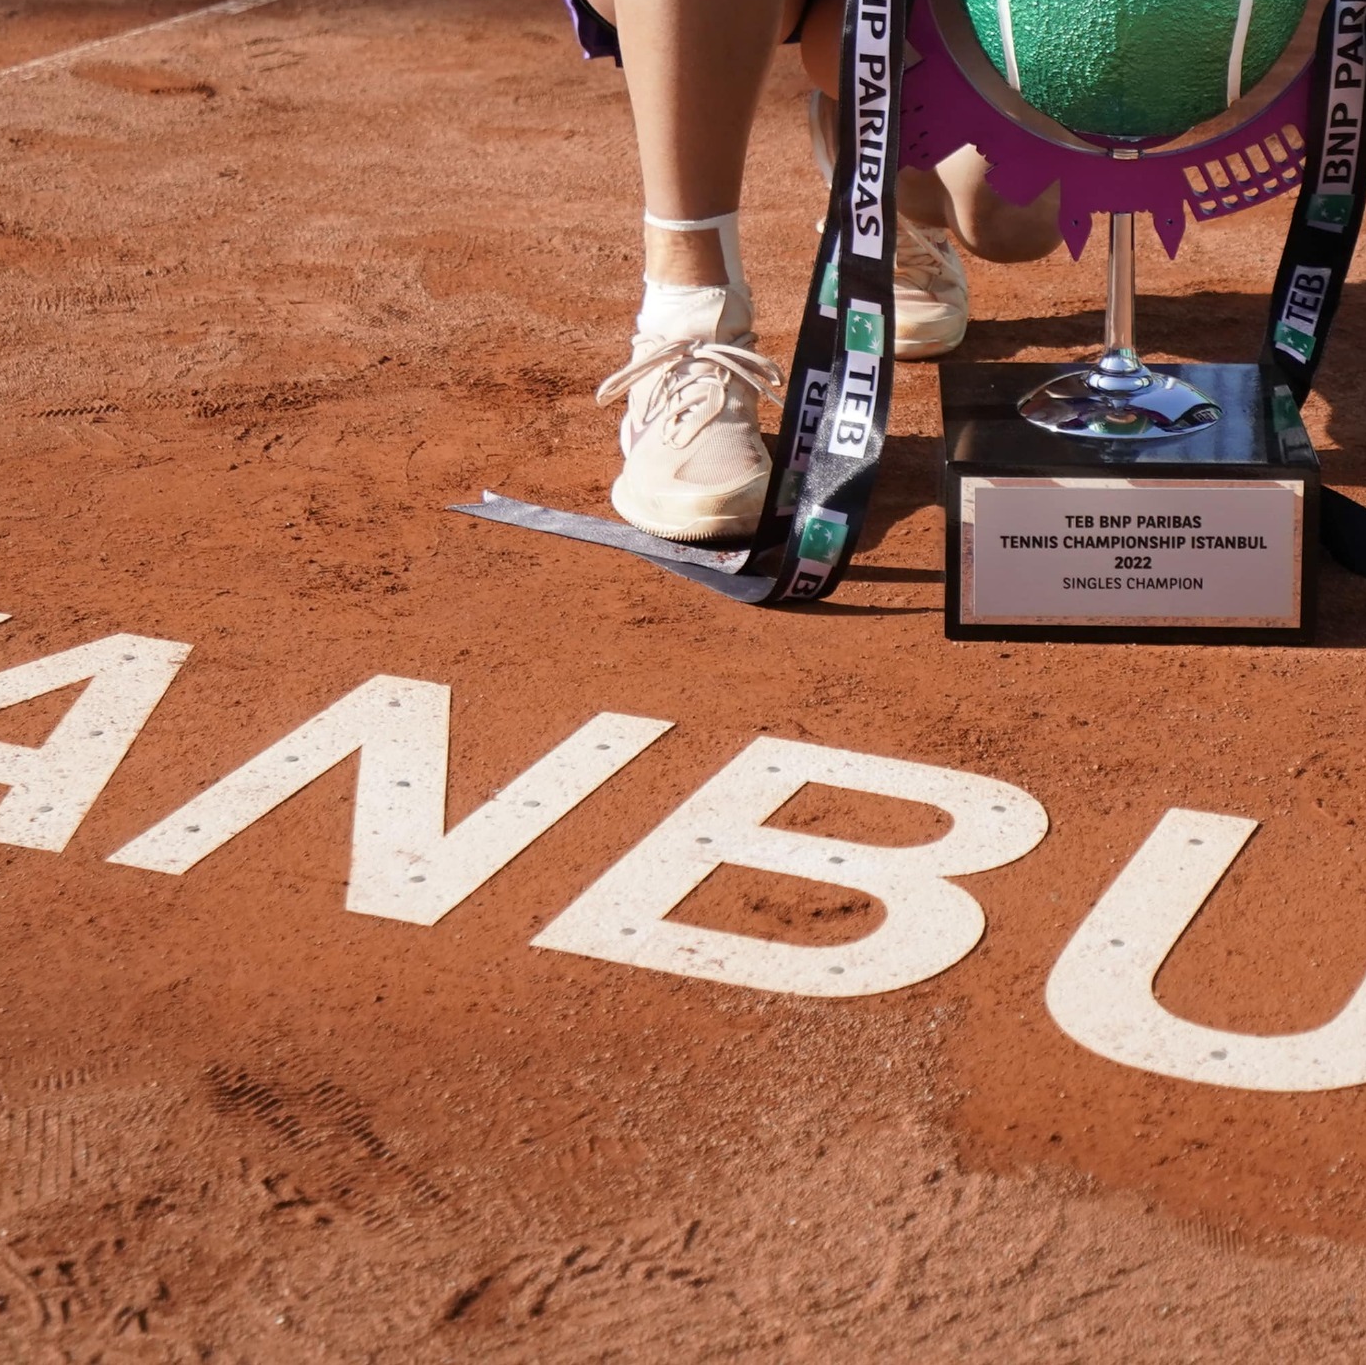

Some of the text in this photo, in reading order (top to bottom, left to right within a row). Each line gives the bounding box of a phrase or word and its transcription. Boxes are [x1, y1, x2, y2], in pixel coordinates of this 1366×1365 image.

[855, 53, 888, 237] PARIBAS
[1323, 106, 1360, 185] BNP
[1286, 272, 1325, 325] TEB
[837, 366, 876, 445] TEB
[1065, 516, 1202, 529] TEB BNP PARIBAS
[1000, 535, 1267, 550] TENNIS CHAMPIONSHIP ISTANBUL
[1114, 556, 1152, 570] 2022
[1063, 577, 1203, 591] SINGLES CHAMPION
